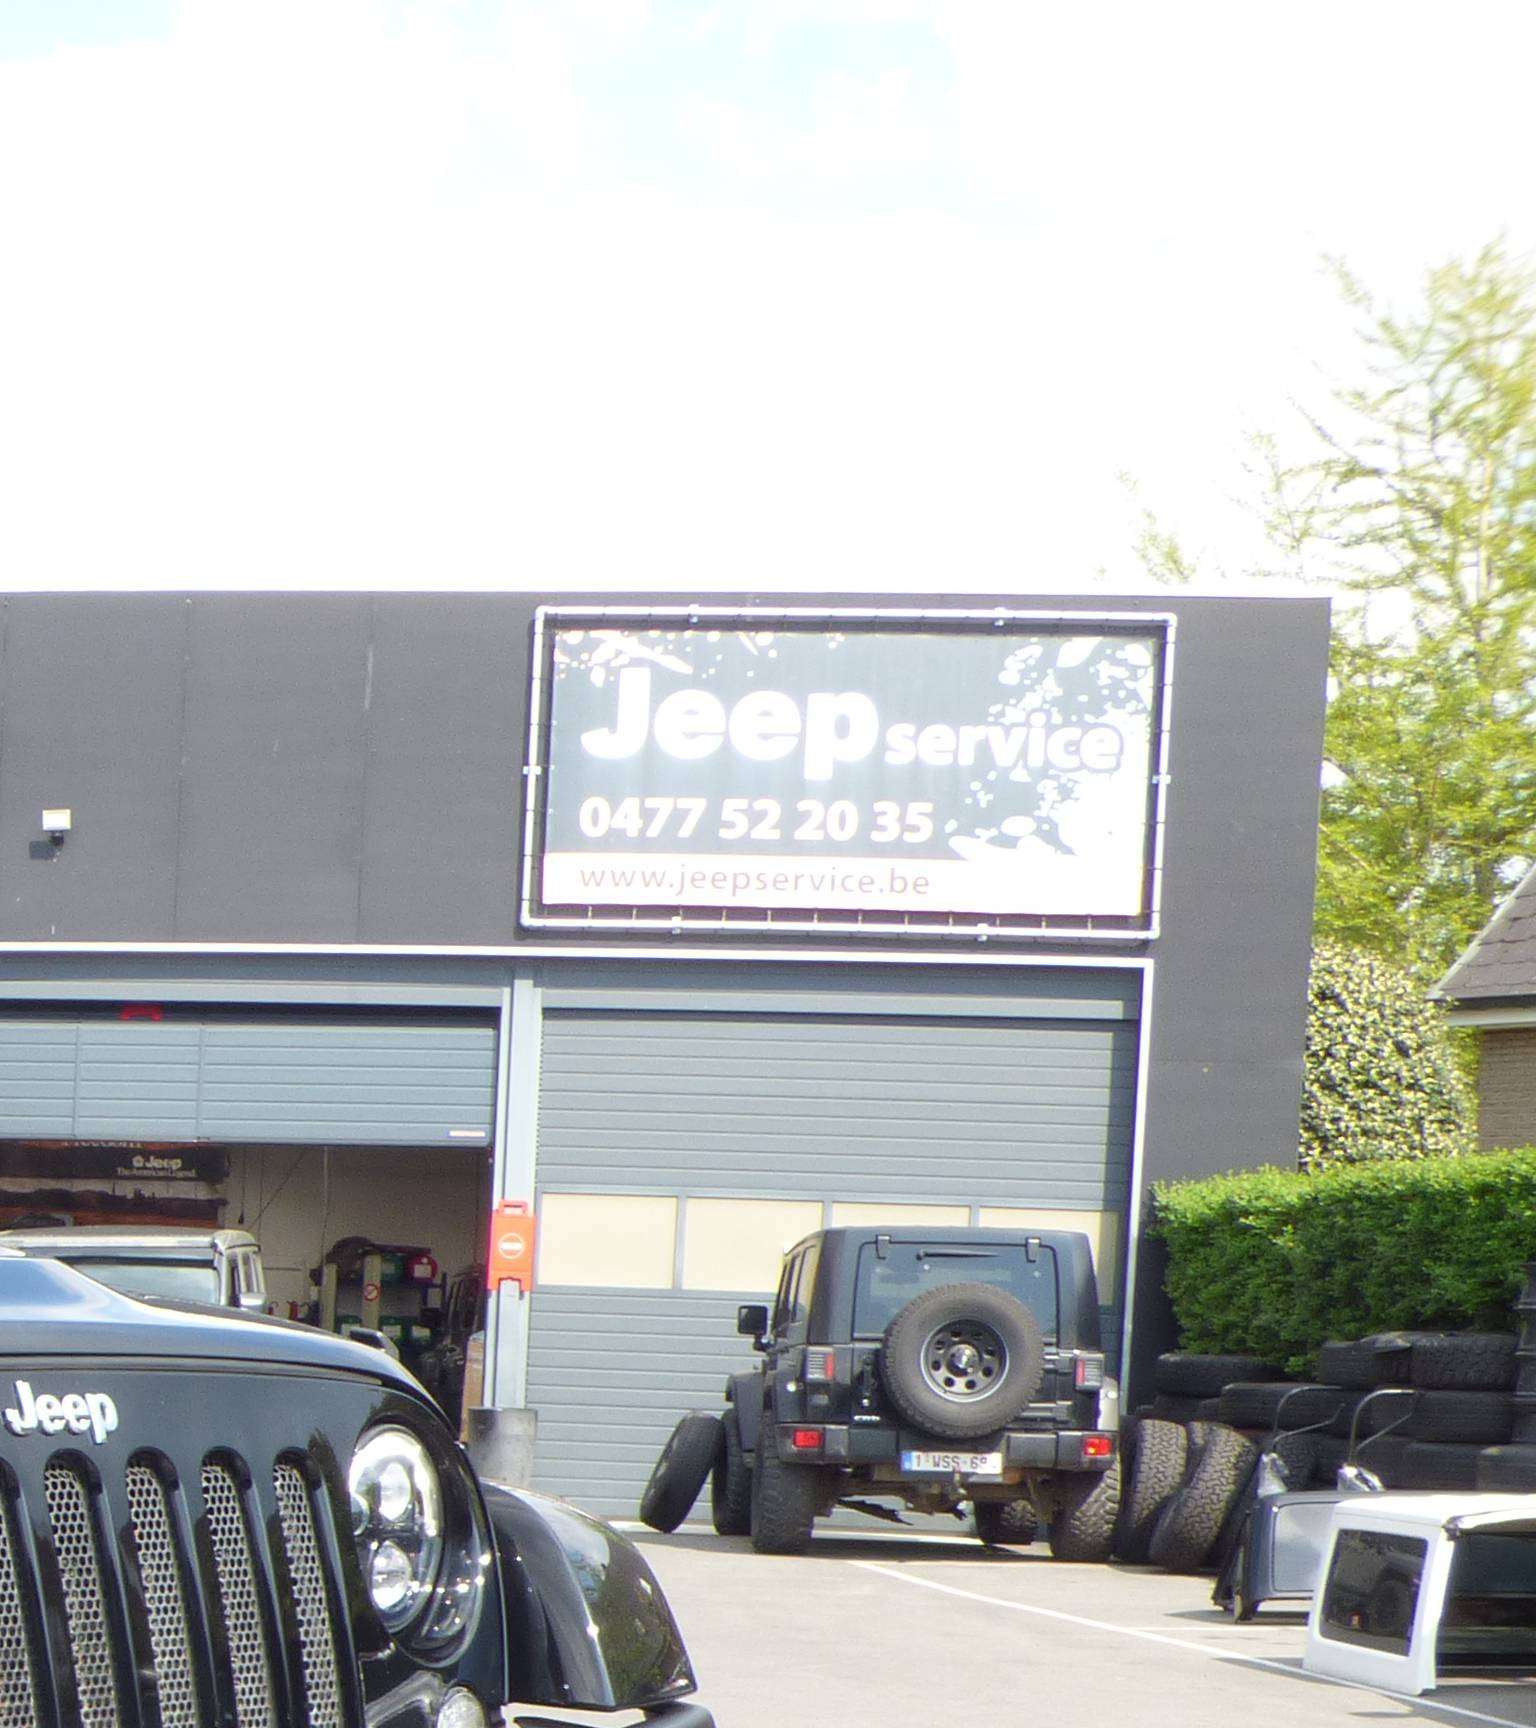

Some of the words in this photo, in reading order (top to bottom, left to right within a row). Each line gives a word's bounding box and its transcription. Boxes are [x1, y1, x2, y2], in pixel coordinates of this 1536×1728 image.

[580, 667, 879, 781] Jeep
[883, 711, 1123, 770] service
[579, 796, 707, 838] 0477
[718, 798, 782, 840] 52
[794, 799, 859, 842] 20
[870, 800, 934, 844] 35
[580, 864, 930, 896] www.jeepservice.be
[145, 1155, 182, 1170] Jeep
[0, 1379, 119, 1445] Jeep
